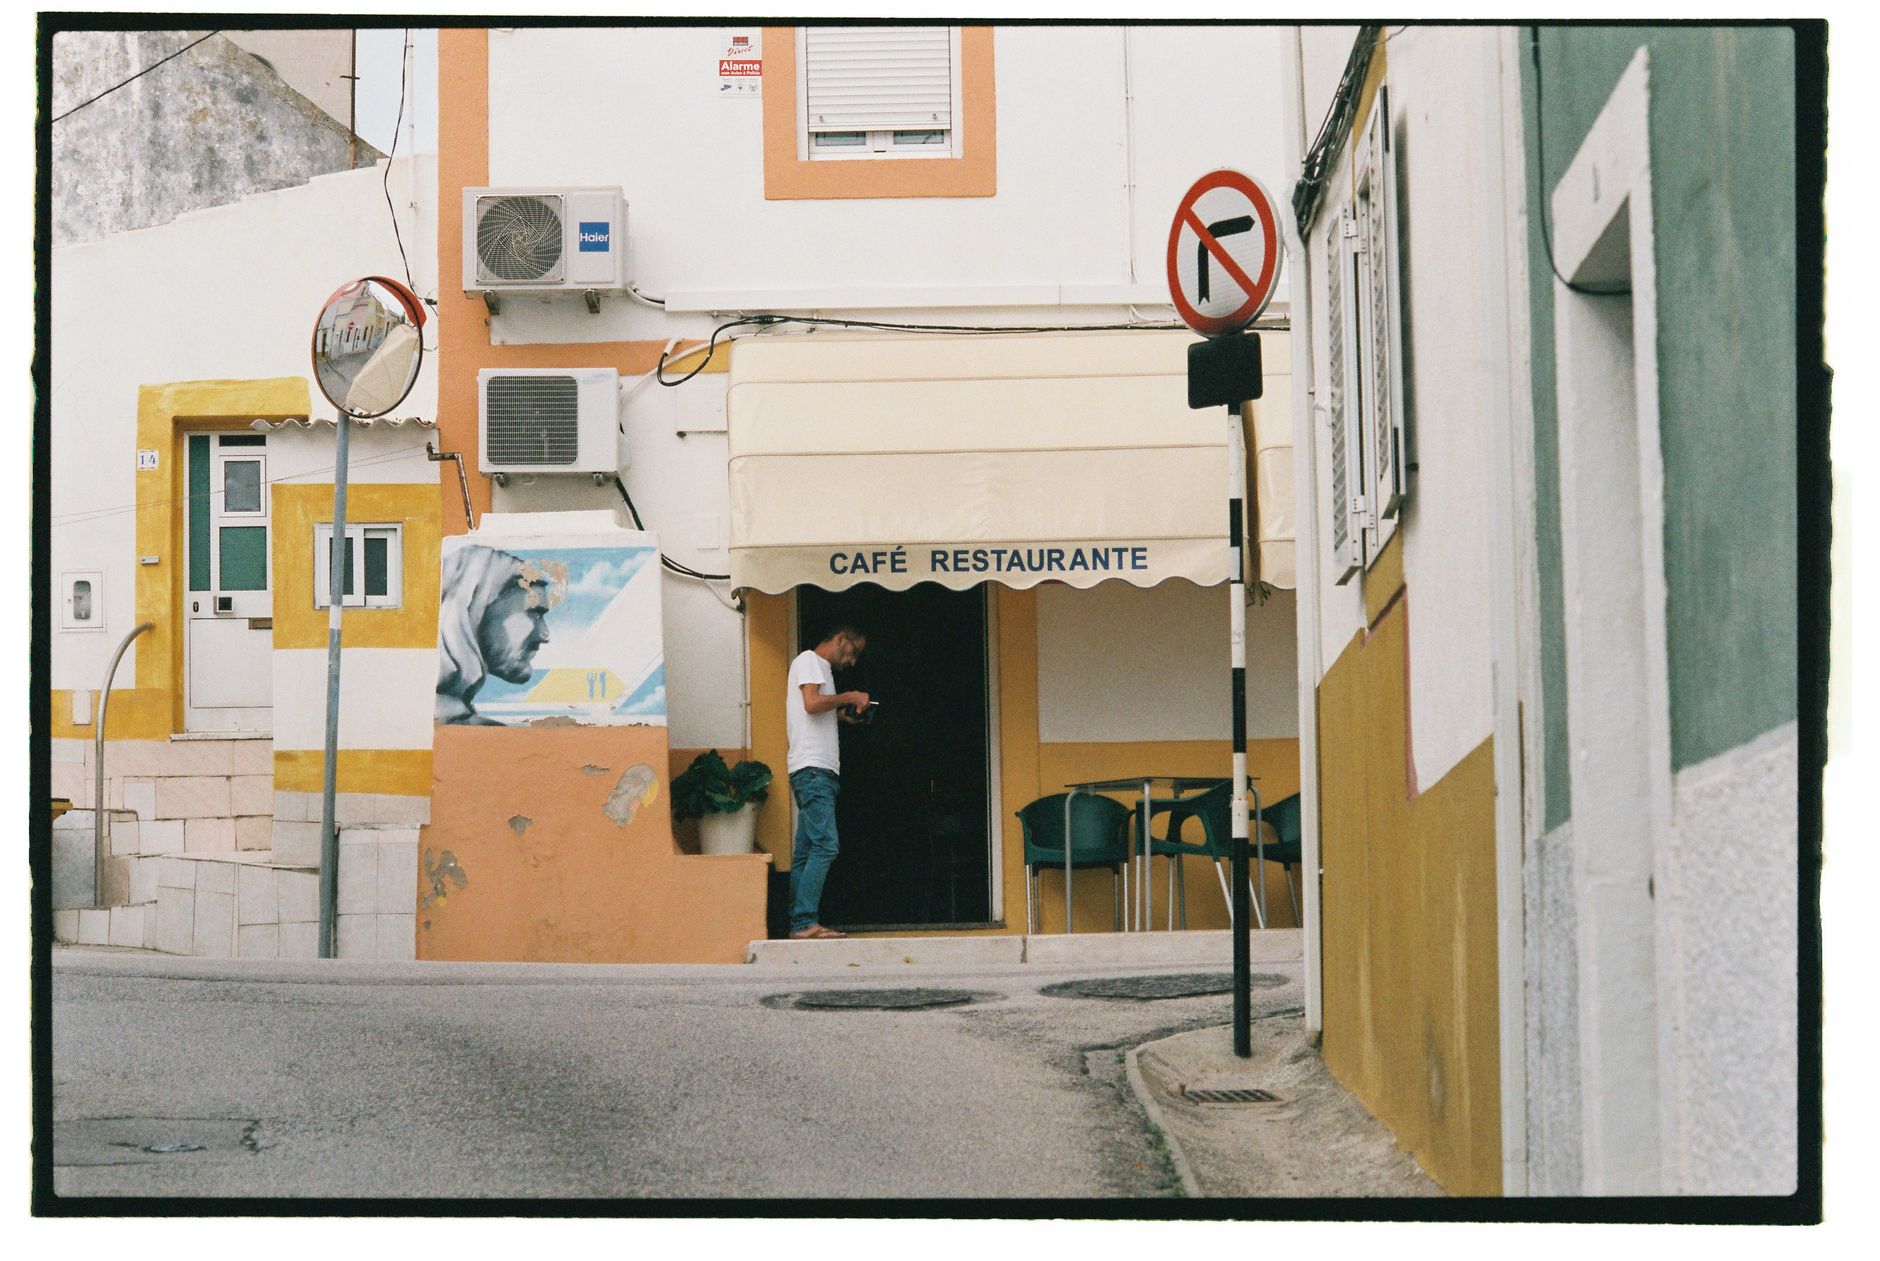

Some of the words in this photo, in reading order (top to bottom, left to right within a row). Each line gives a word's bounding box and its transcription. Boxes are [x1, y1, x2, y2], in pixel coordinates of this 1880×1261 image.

[720, 61, 760, 71] Alarme
[580, 232, 609, 242] Haier
[141, 454, 156, 465] 14
[829, 545, 908, 575] CAFÉ
[930, 547, 1148, 573] RESTAURANTE
